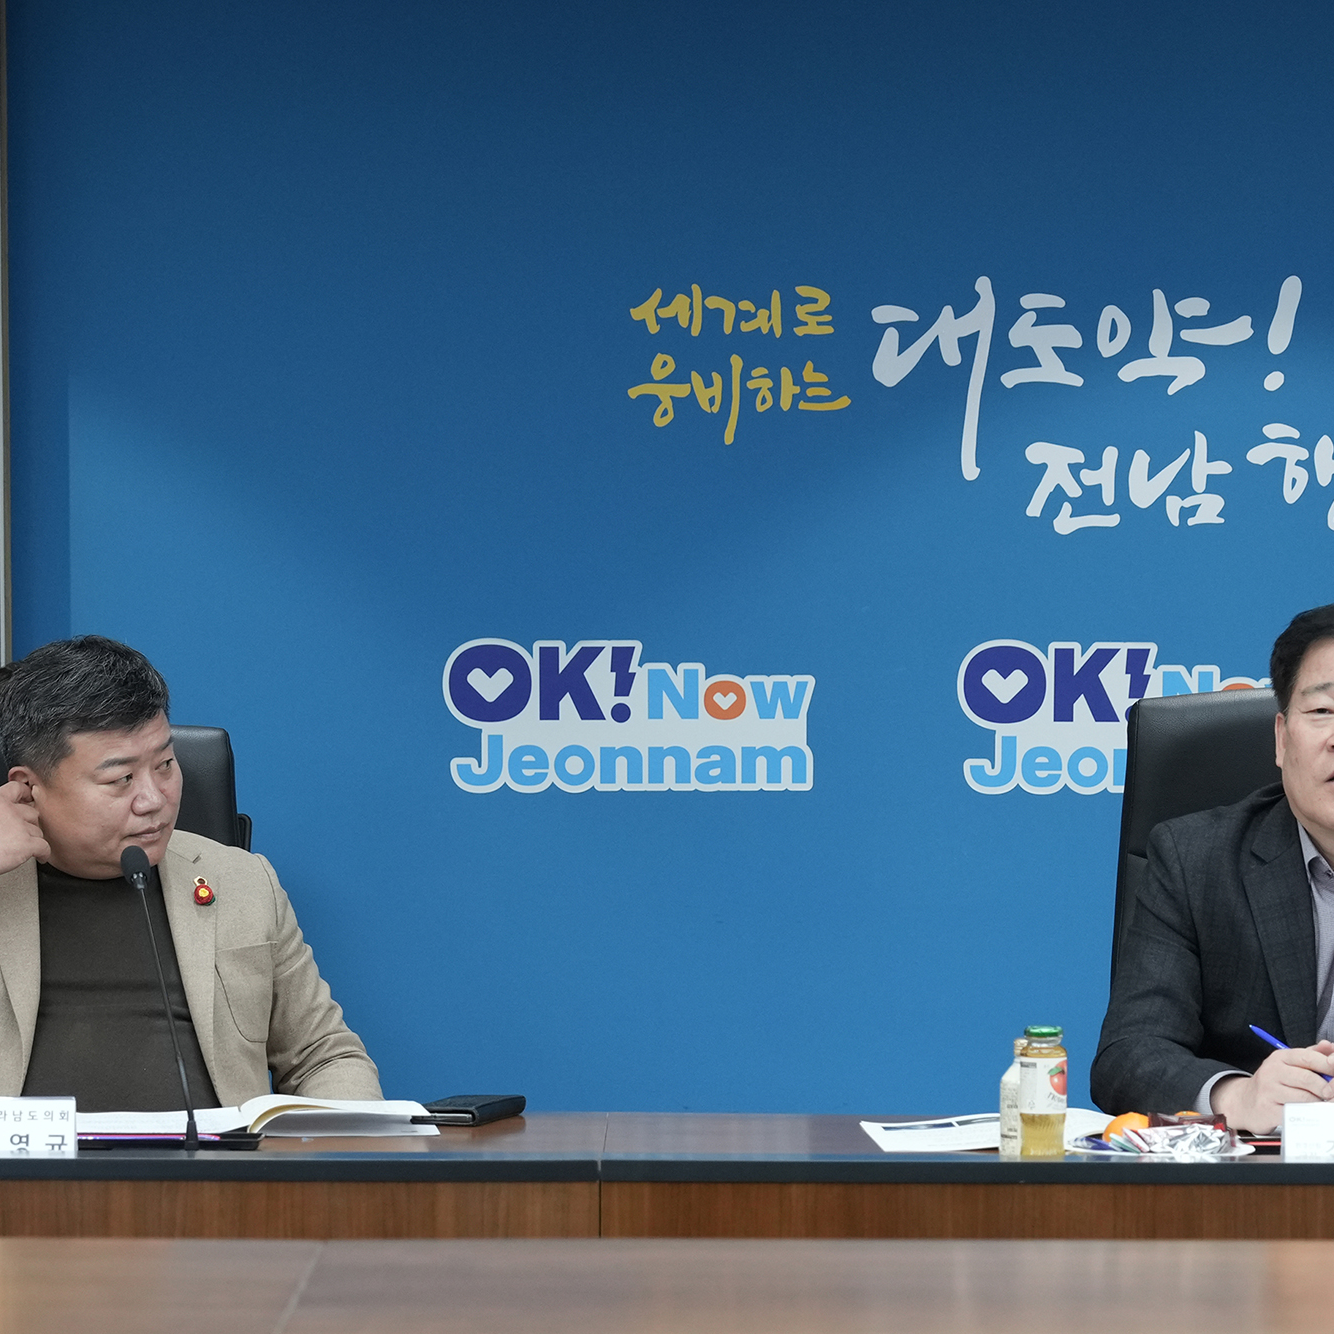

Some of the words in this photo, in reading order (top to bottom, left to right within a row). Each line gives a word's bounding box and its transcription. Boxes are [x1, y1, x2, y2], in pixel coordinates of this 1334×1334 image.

[629, 284, 835, 338] 세계로
[627, 354, 852, 445] 웅비하는
[871, 275, 1302, 480] 대도약!
[1025, 430, 1233, 535] 전남
[448, 643, 637, 724] OK!
[646, 668, 809, 721] Now
[456, 733, 808, 787] Jeonnam
